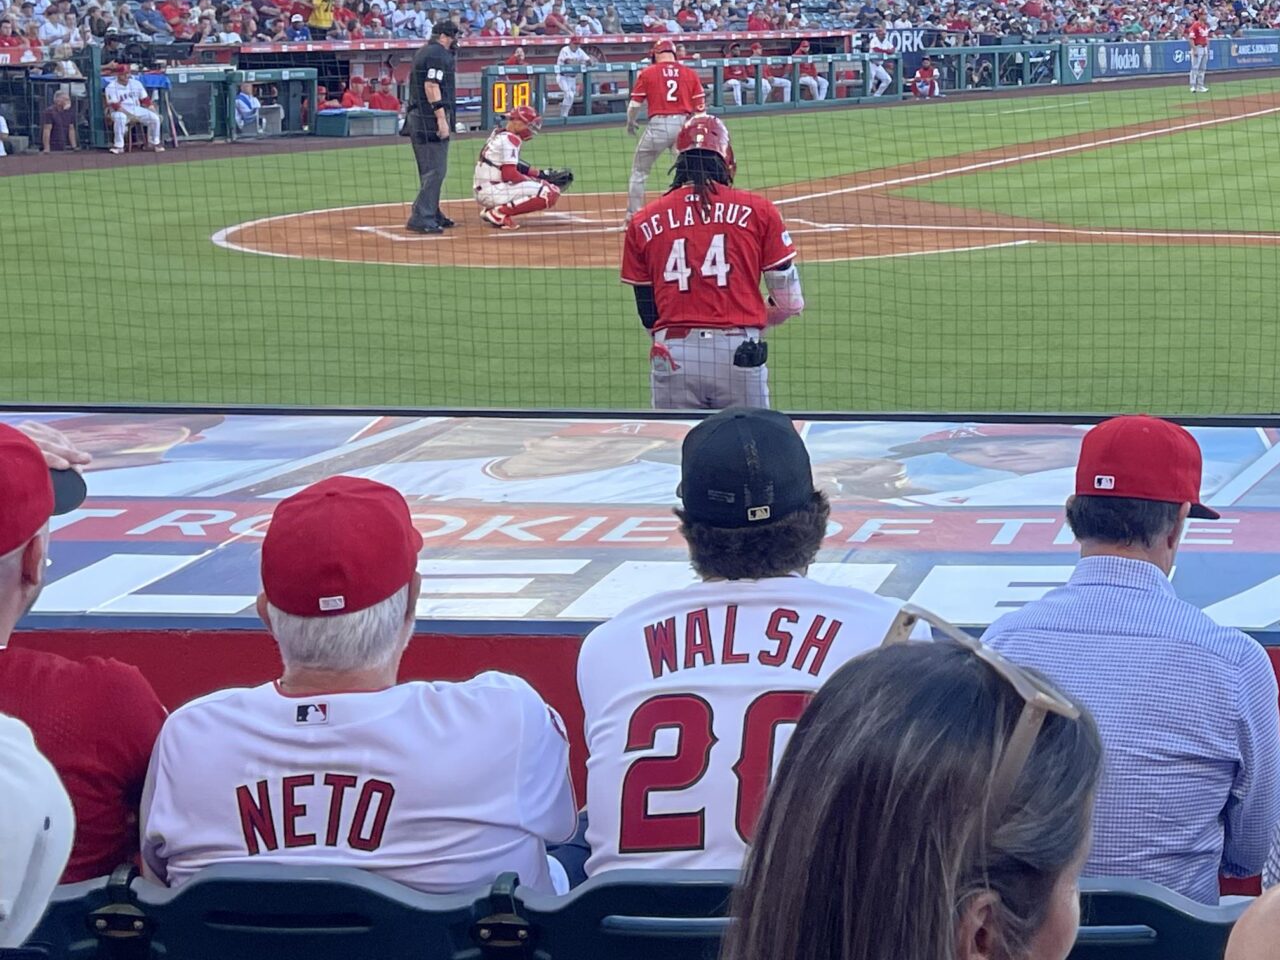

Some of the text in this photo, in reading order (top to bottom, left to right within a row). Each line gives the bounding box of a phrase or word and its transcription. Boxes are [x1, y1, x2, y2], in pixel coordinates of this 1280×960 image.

[852, 30, 924, 53] EORK
[1069, 48, 1088, 57] MLB
[662, 68, 680, 77] LUX
[1111, 48, 1140, 70] Modelo
[667, 80, 678, 102] 2
[640, 202, 752, 242] DE LA CRUZ
[663, 233, 731, 292] 44
[644, 604, 842, 680] WALSH
[618, 690, 818, 854] 20
[235, 772, 396, 856] NETO
